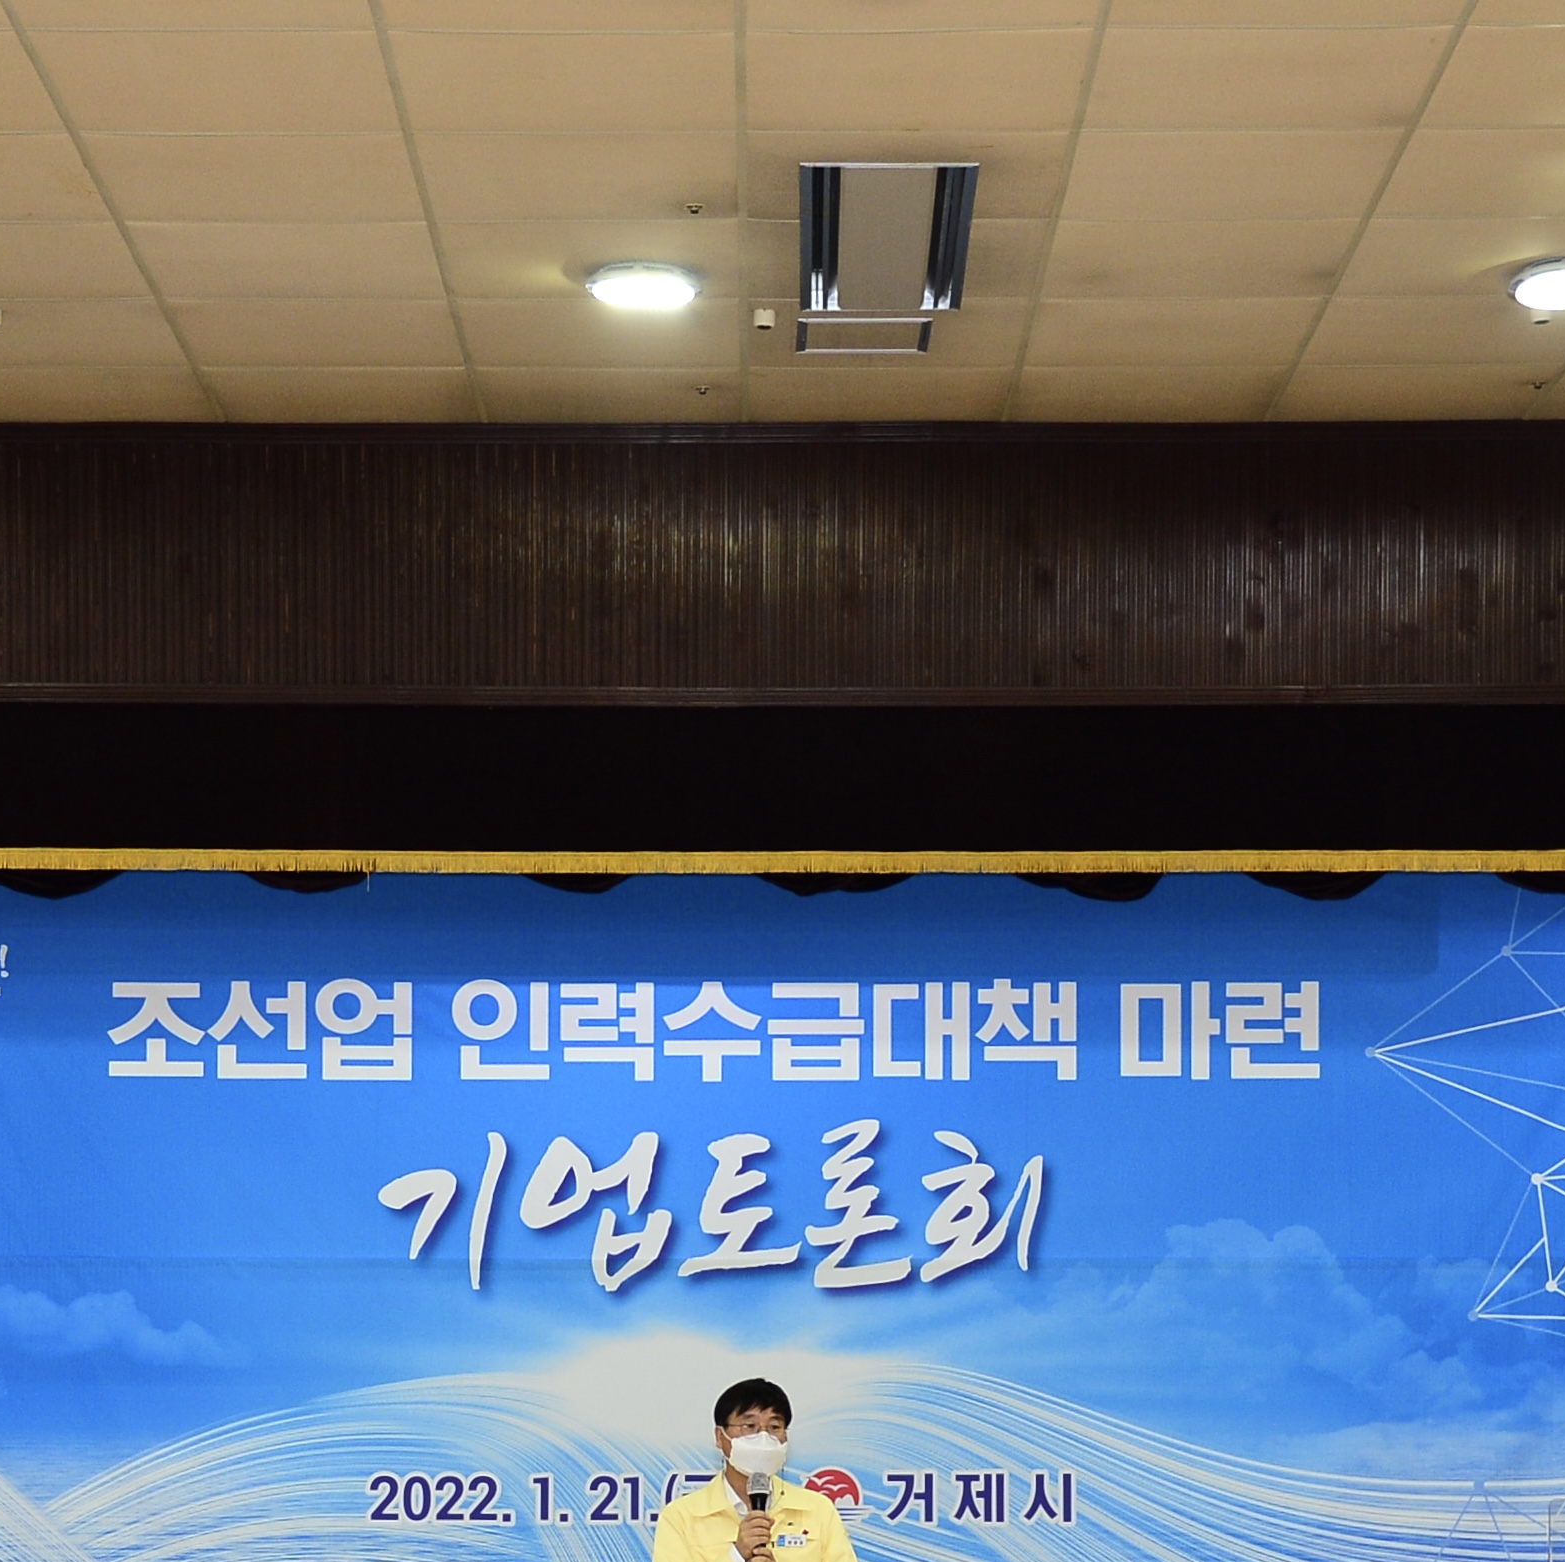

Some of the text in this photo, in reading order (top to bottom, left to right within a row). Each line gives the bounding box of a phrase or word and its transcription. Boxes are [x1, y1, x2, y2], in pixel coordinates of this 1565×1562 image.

[107, 978, 1321, 1082] 조선업 인력수급대책 마련
[379, 1119, 1043, 1292] 기업토론회
[370, 1475, 511, 1522] 2022.
[533, 1476, 568, 1522] 1.
[887, 1473, 1072, 1522] 거제시
